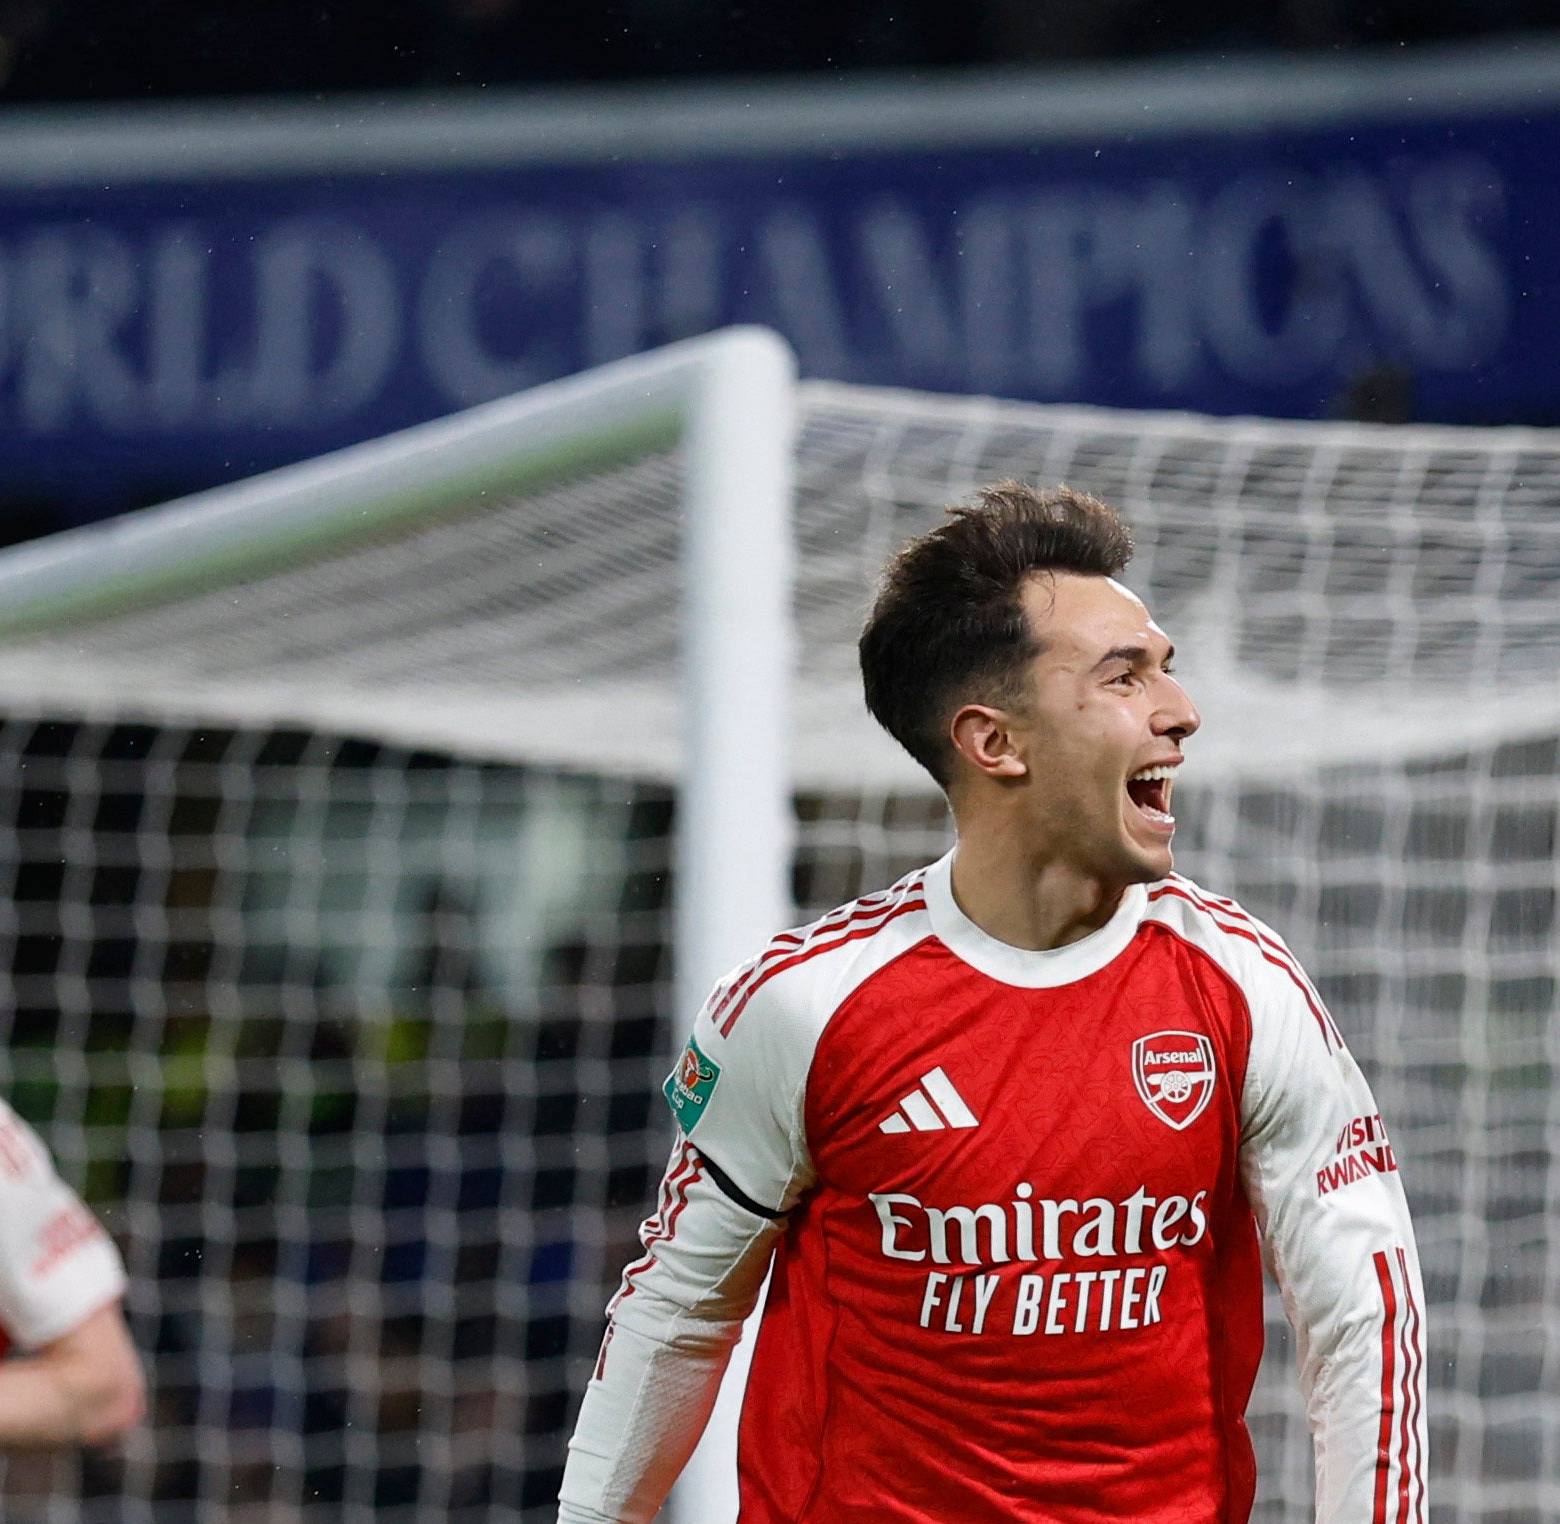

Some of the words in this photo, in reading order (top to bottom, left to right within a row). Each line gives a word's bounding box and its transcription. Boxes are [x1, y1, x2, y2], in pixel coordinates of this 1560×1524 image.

[419, 150, 1511, 405] CHAMPIONS
[1144, 1047, 1203, 1065] Arsenal
[1335, 1113, 1385, 1154] VISIT
[1316, 1144, 1398, 1197] RWAND
[868, 1182, 1207, 1265] Emirates
[920, 1271, 1000, 1334] FLY
[1012, 1265, 1168, 1335] BETTER
